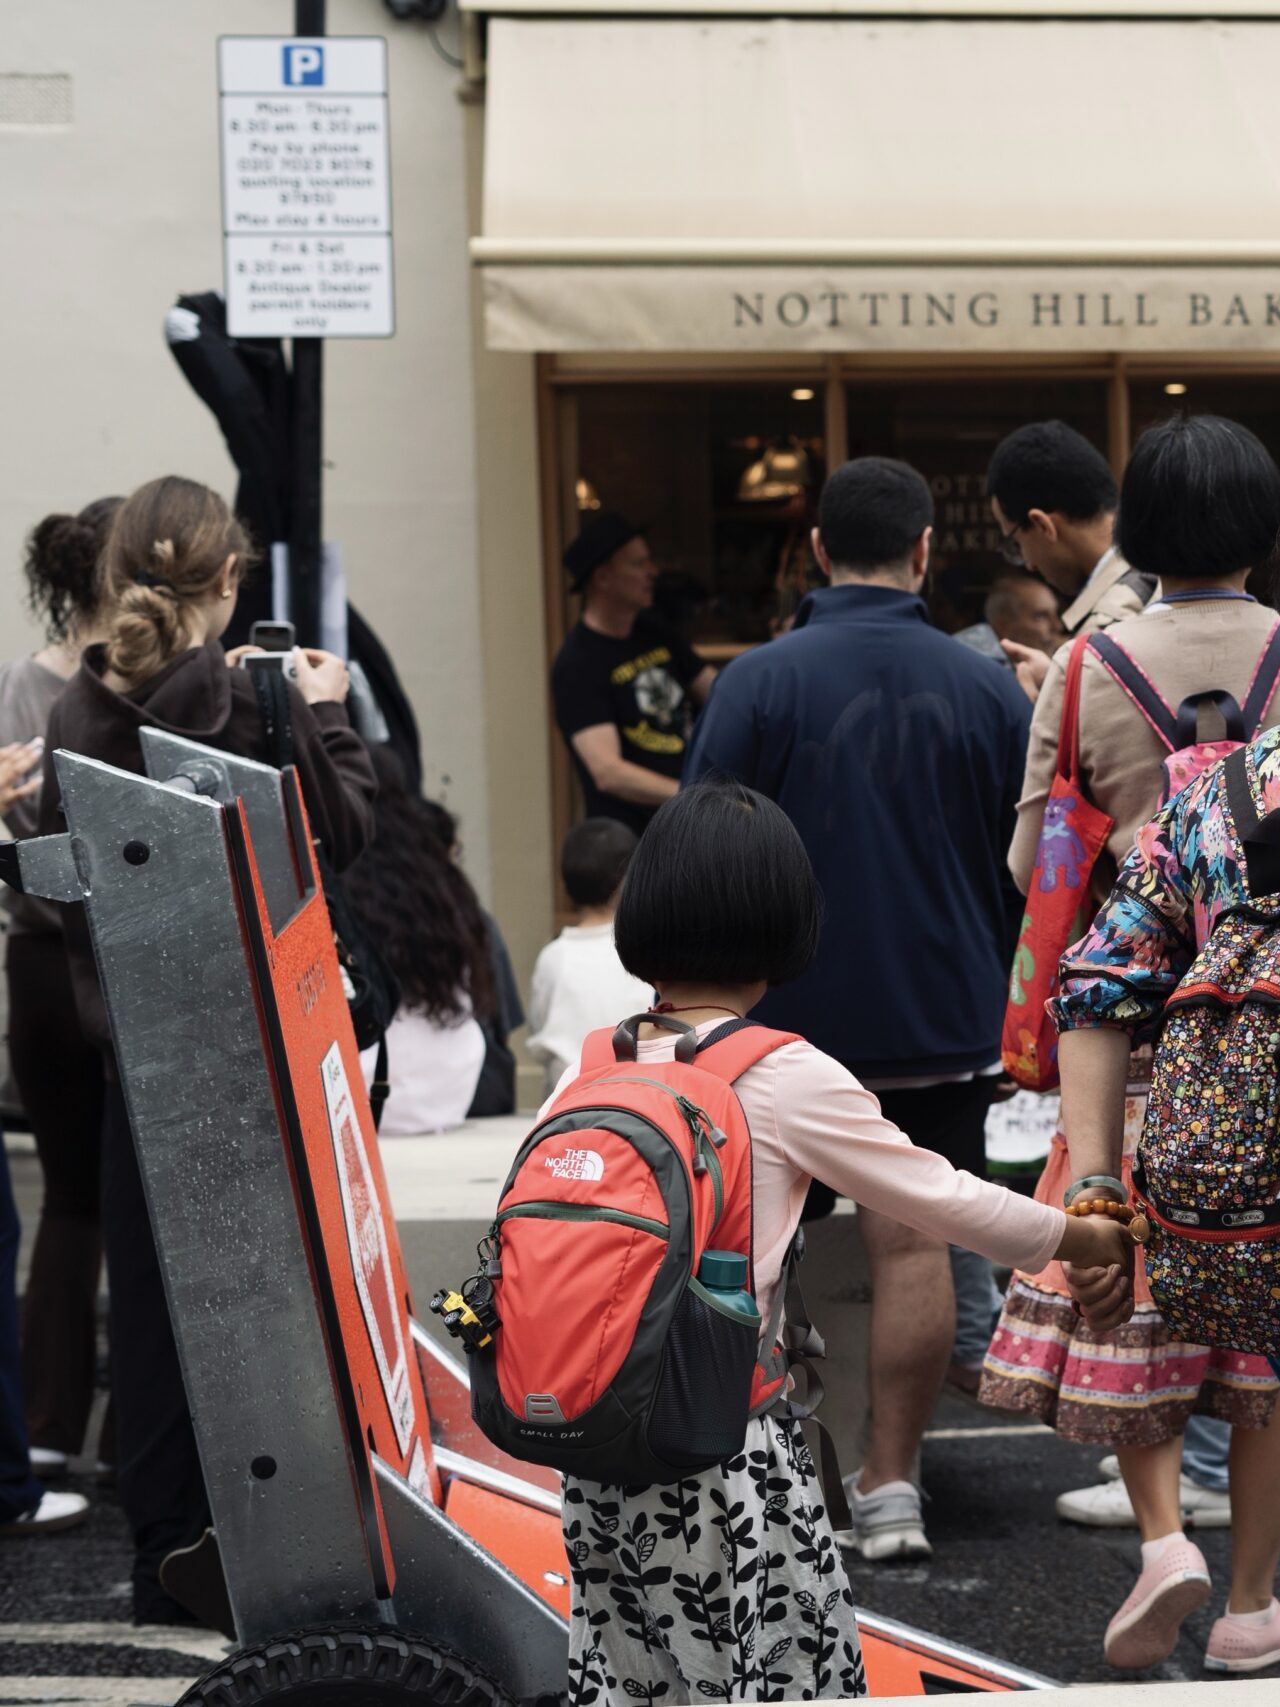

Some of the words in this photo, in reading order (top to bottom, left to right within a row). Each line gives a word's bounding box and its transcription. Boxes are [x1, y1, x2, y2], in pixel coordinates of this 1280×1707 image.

[290, 48, 321, 85] P
[256, 102, 292, 115] Mon
[304, 101, 352, 115] Thurs
[249, 141, 279, 155] Pay
[285, 141, 306, 155] by
[310, 141, 362, 154] phone
[238, 175, 302, 190] quoting
[307, 175, 374, 189] location
[235, 212, 269, 226] Max
[274, 212, 311, 229] stay
[333, 212, 380, 226] hours
[271, 241, 294, 255] Fri
[298, 241, 309, 255] &
[316, 241, 345, 255] Sat
[248, 280, 313, 296] Antique
[318, 280, 373, 294] Dealer
[249, 297, 304, 312] permit
[309, 297, 371, 311] holders
[733, 292, 1000, 328] NOTTING
[1030, 292, 1159, 328] HILL
[293, 314, 329, 330] only
[564, 1148, 588, 1160] THE
[544, 1156, 584, 1170] NORTH
[551, 1168, 582, 1180] FACE
[519, 1428, 555, 1439] SMALL
[560, 1430, 585, 1440] DAY
